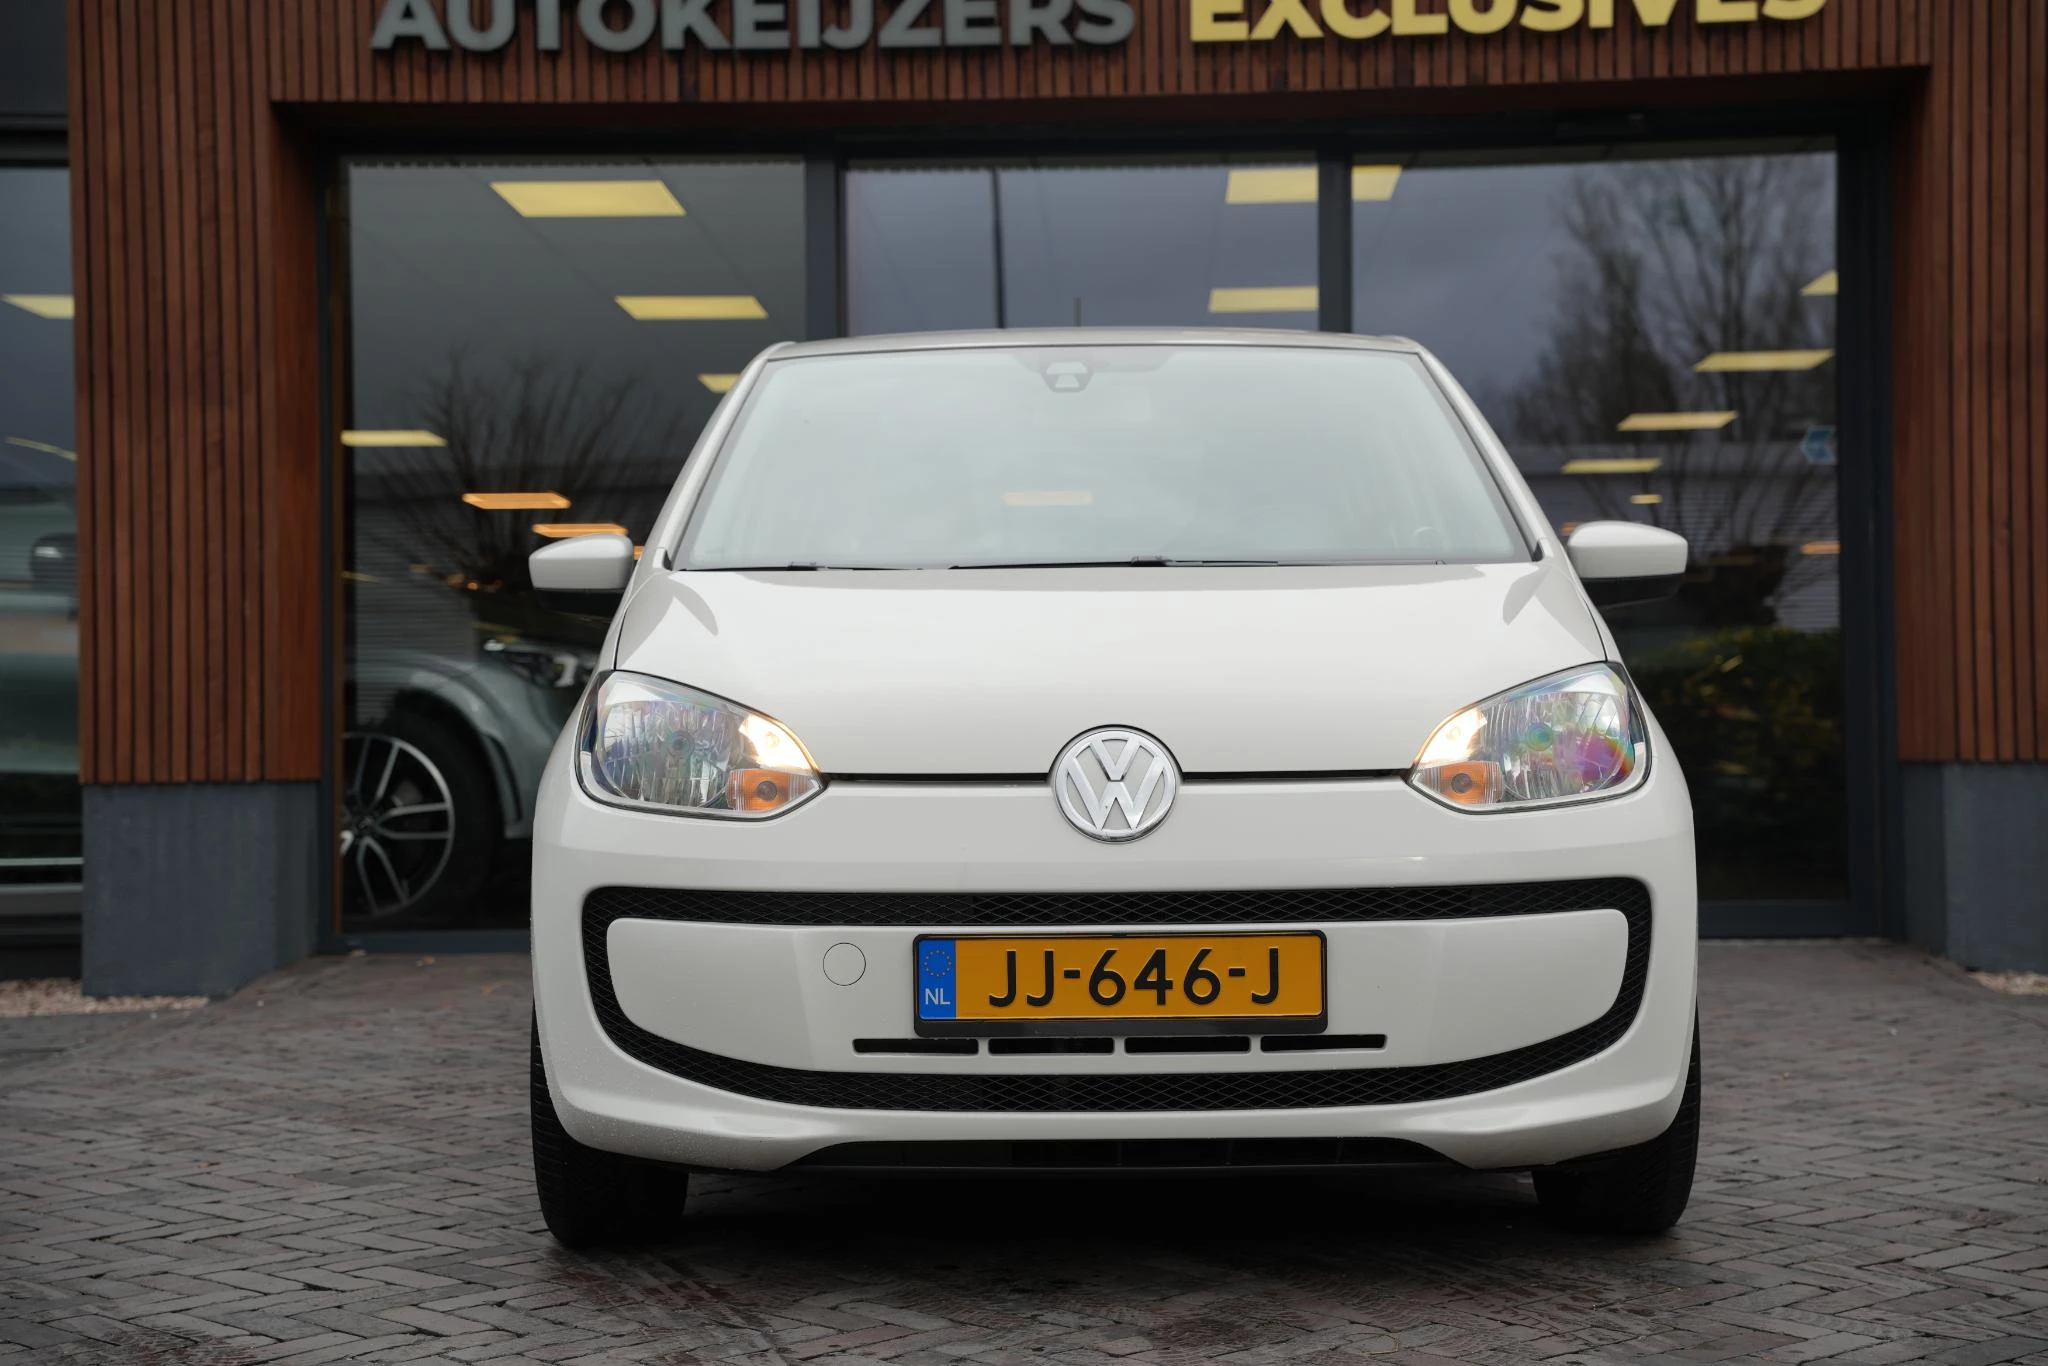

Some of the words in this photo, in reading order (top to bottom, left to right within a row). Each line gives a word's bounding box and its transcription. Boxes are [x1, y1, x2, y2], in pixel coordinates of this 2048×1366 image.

[370, 0, 1135, 52] AUTOKEIJZERS
[1190, 0, 1828, 42] EXCLU
[1058, 732, 1173, 838] VW
[924, 988, 951, 1006] NL
[988, 947, 1280, 1008] JJ-646-J
